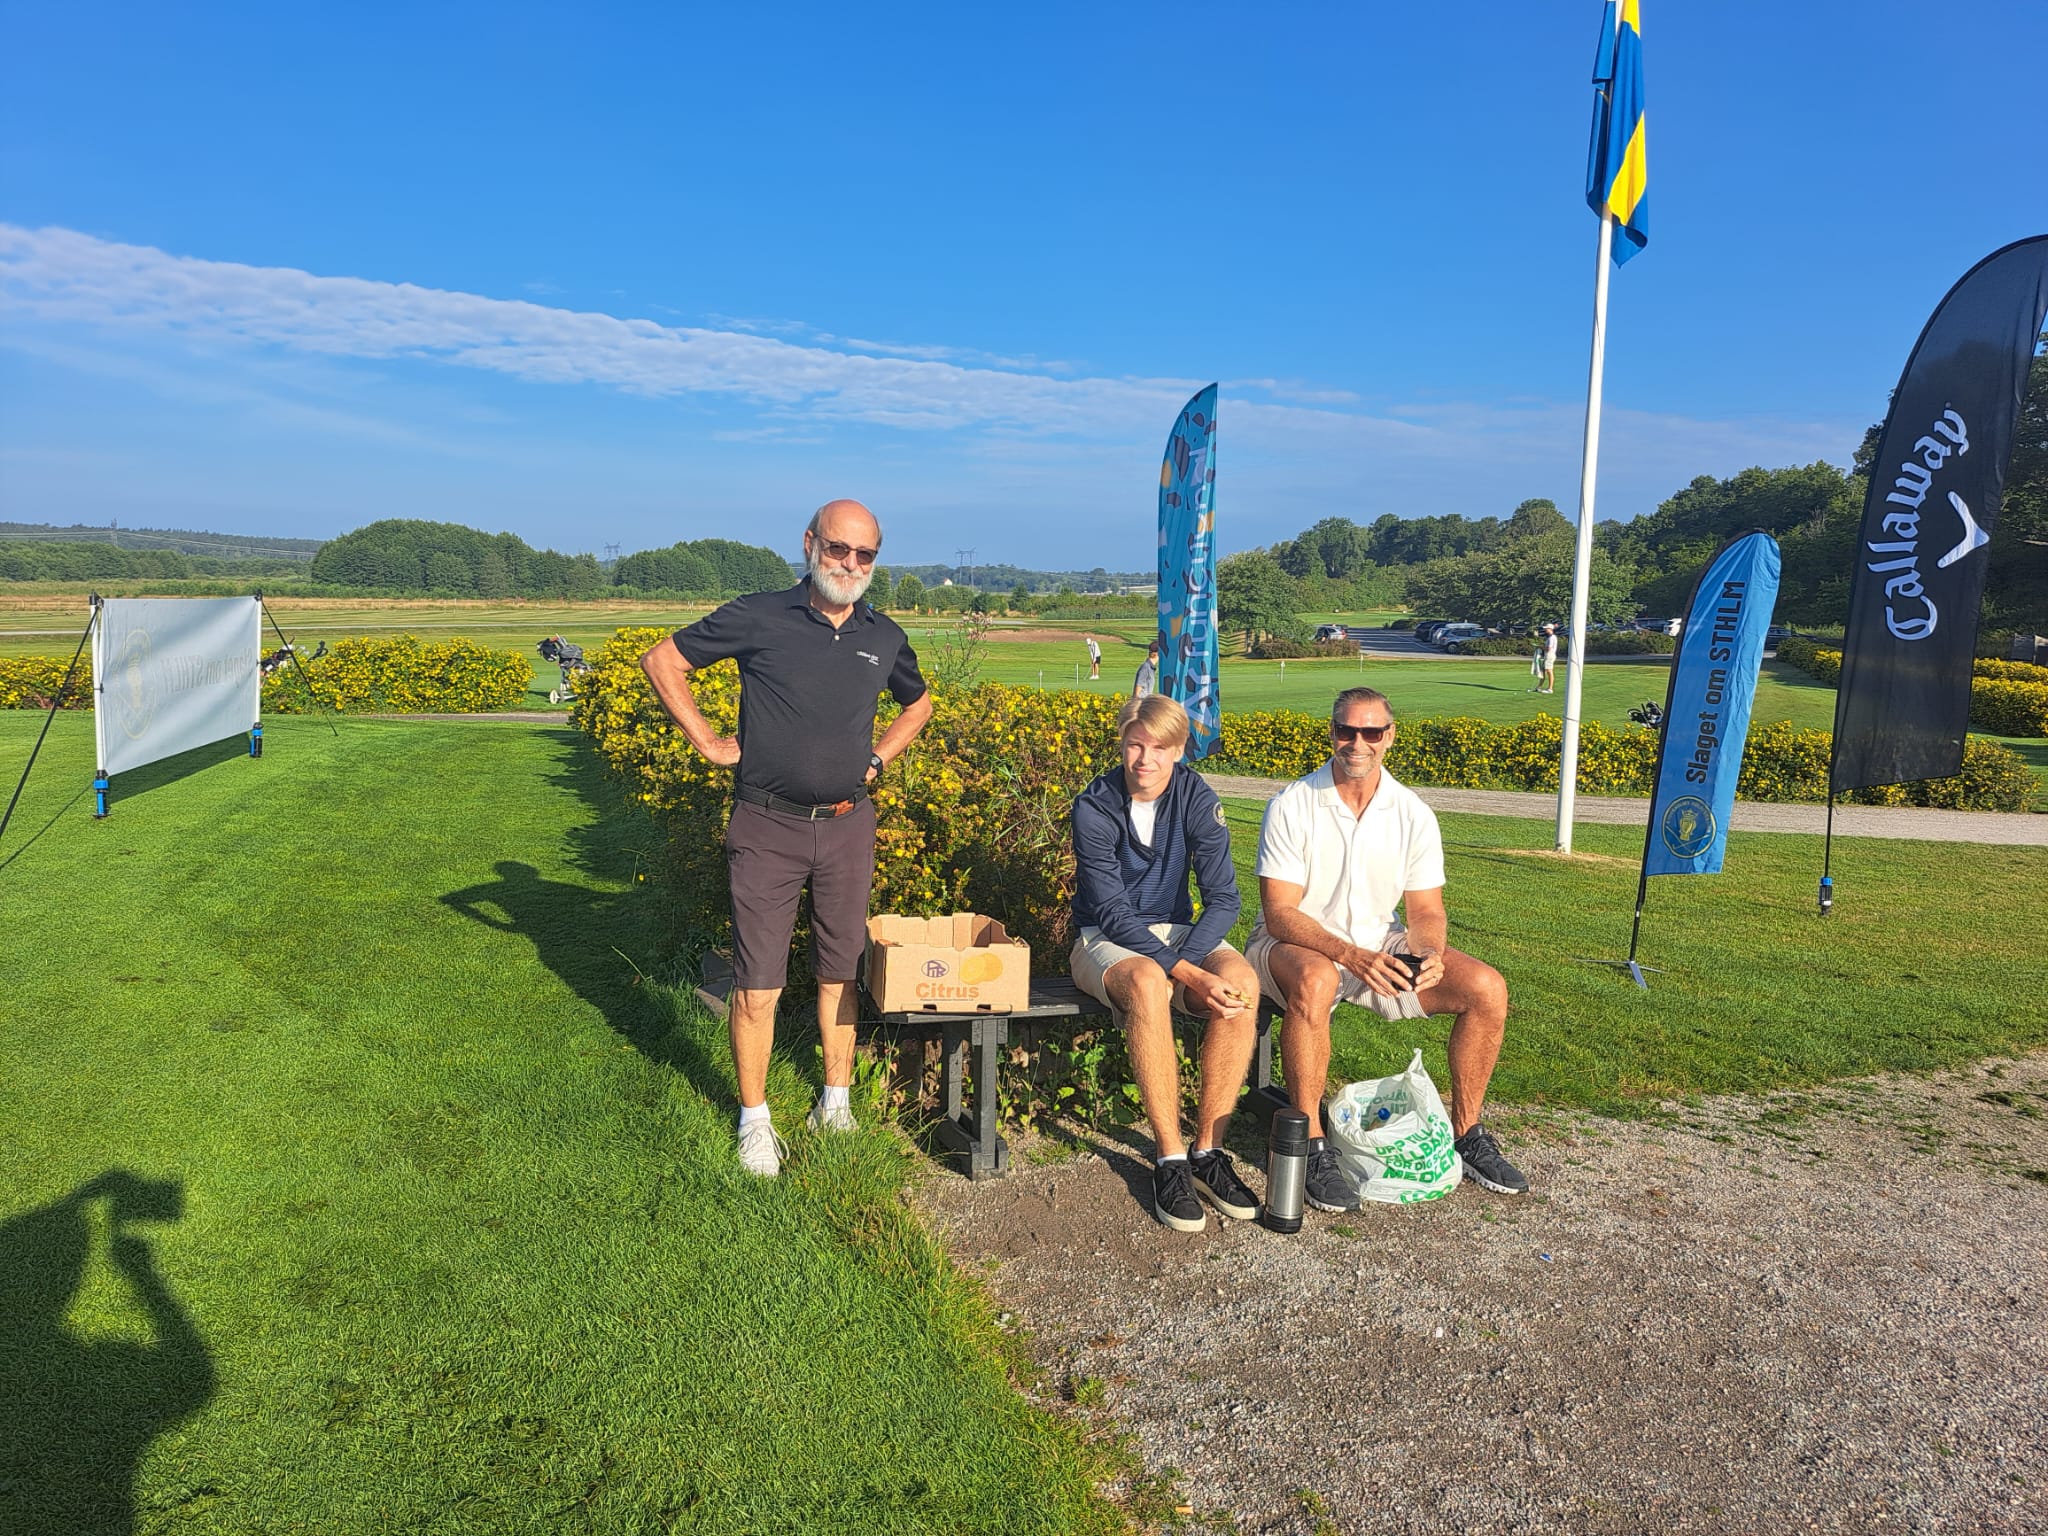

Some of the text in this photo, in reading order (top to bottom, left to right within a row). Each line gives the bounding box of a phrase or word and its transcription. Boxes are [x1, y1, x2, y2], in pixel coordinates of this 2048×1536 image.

[1866, 408, 1970, 640] Callaway
[1709, 580, 1746, 662] STHLM
[1704, 669, 1728, 705] om
[1685, 711, 1720, 785] Slaget
[915, 982, 980, 999] Citrus
